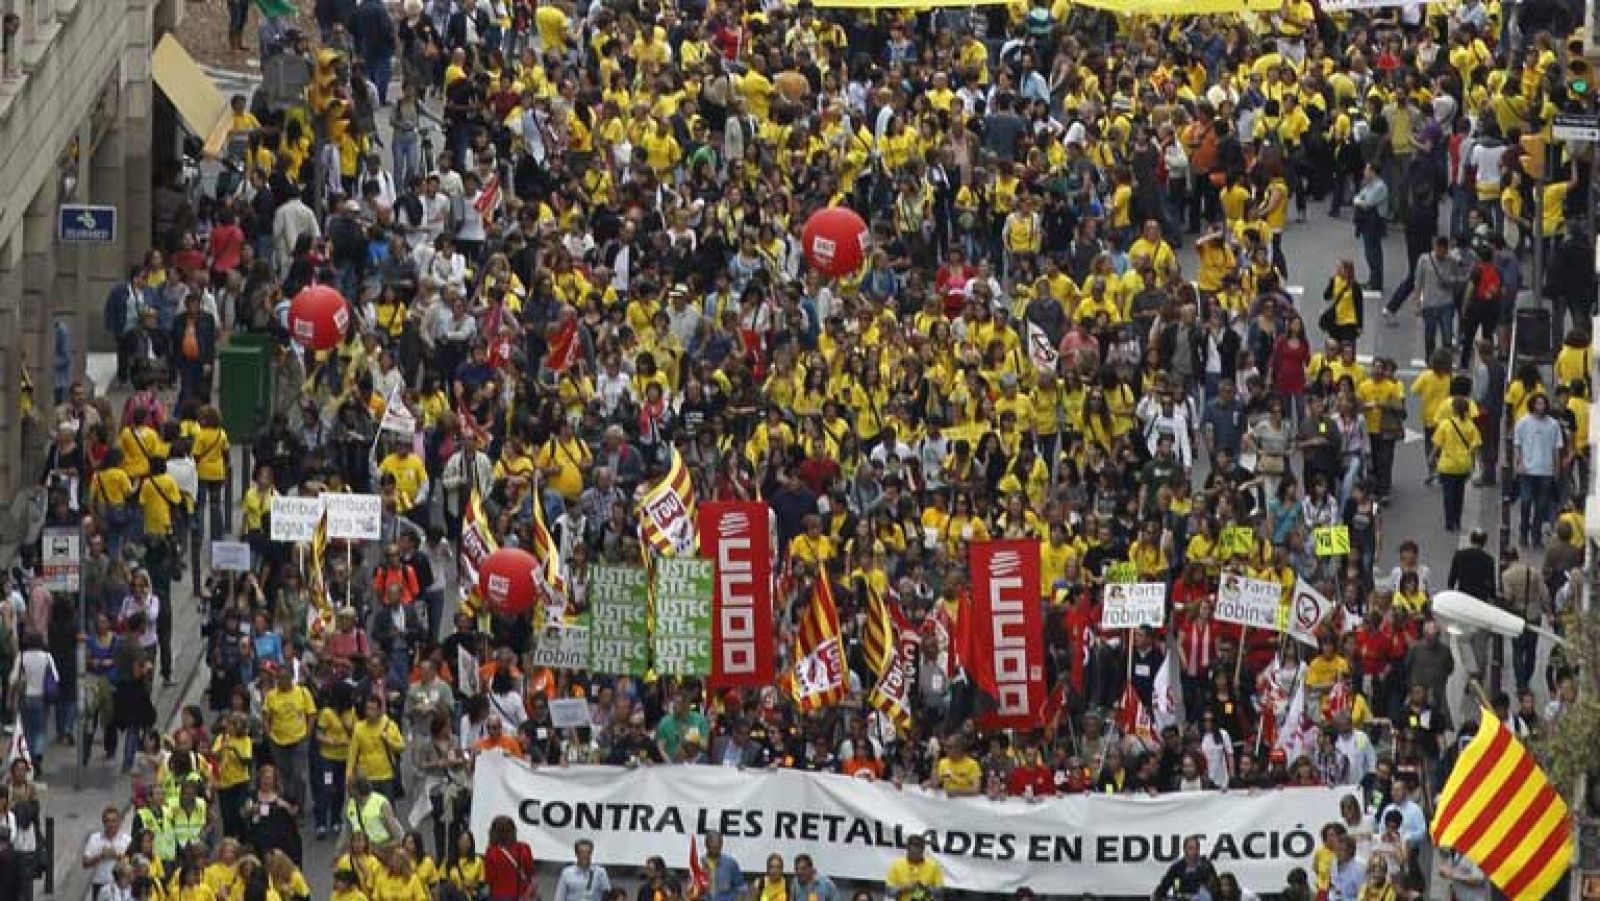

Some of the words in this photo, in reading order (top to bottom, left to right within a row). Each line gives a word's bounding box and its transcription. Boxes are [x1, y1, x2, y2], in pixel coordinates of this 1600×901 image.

[593, 565, 646, 586] USTEC
[655, 558, 711, 580] USTEC
[592, 602, 645, 623] USTEC
[655, 597, 711, 618] USTEC
[719, 538, 755, 673] CCOO
[1218, 600, 1260, 623] robin
[534, 646, 580, 664] robin
[593, 640, 645, 660] USTEC
[655, 636, 710, 658] USTEC
[990, 577, 1029, 715] CCOO
[518, 799, 685, 834] CONTRA
[698, 808, 763, 838] LES
[775, 811, 1016, 860] RETALLADES
[1028, 835, 1083, 863] EN
[1096, 823, 1315, 864] EDUACIÓ
